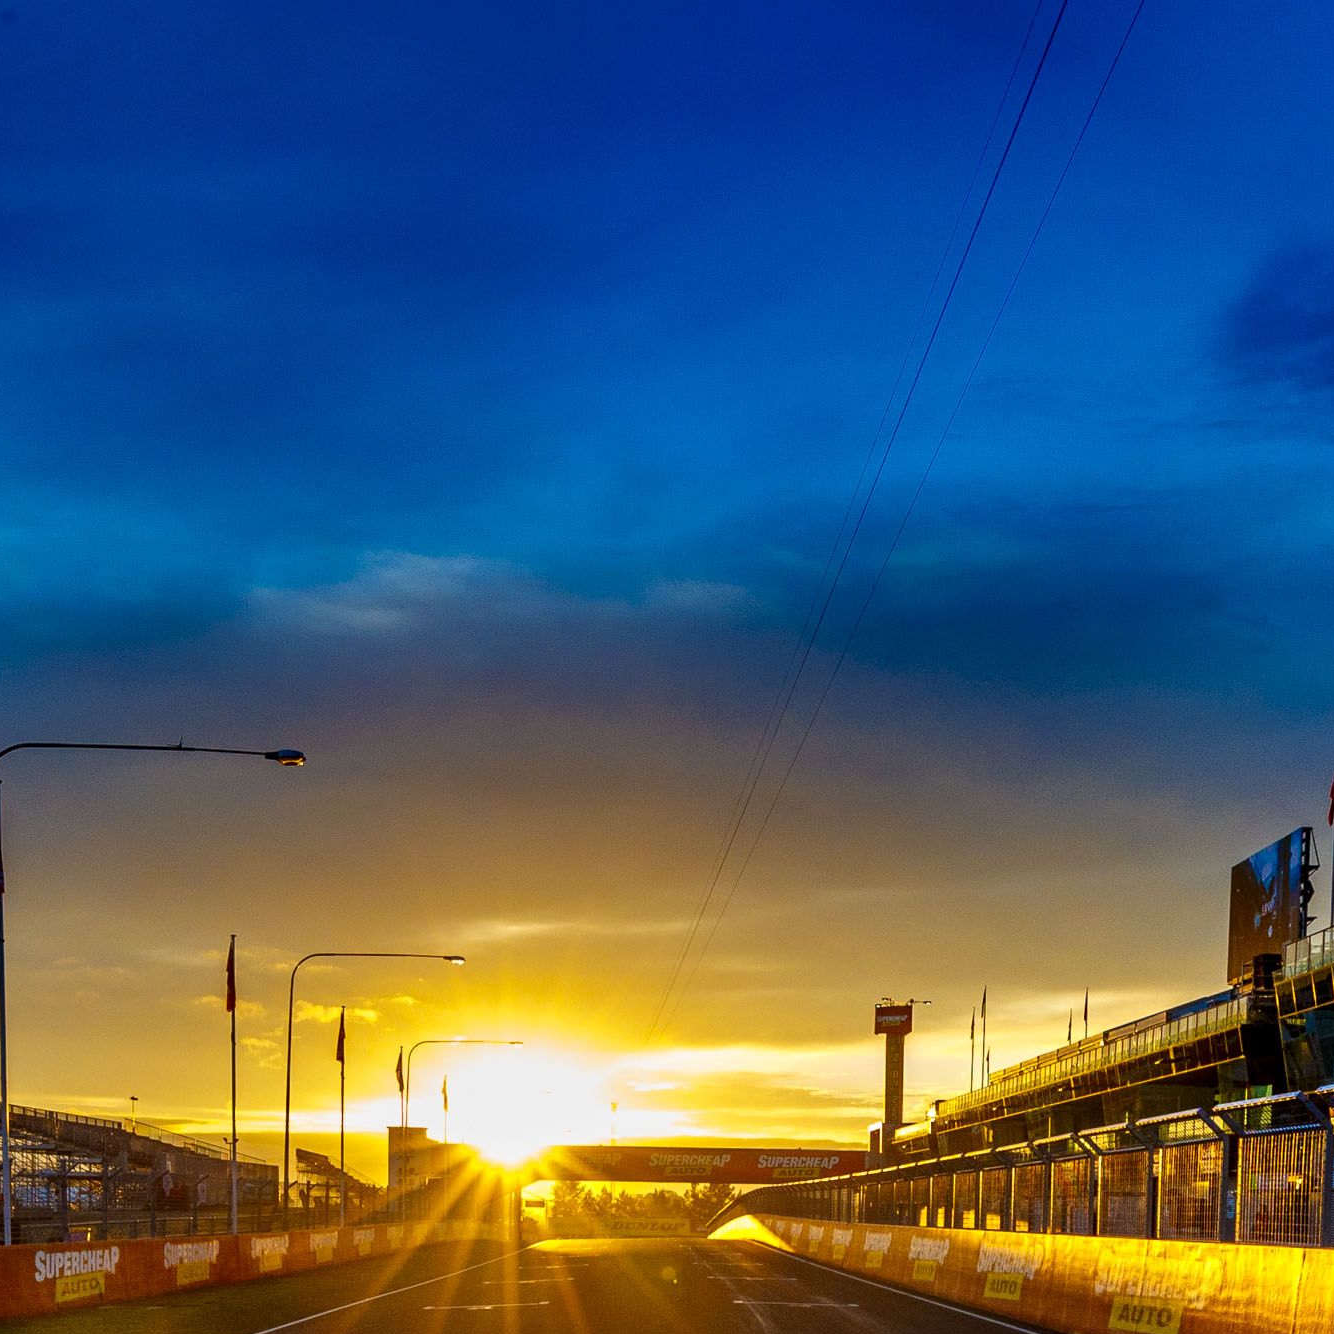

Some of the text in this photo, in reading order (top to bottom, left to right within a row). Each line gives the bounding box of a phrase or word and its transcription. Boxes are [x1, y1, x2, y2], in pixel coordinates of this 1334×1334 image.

[757, 1154, 840, 1170] SUPERCHEAP
[34, 1245, 120, 1283] SUPERCHEAP
[1118, 1303, 1173, 1328] AUTO
